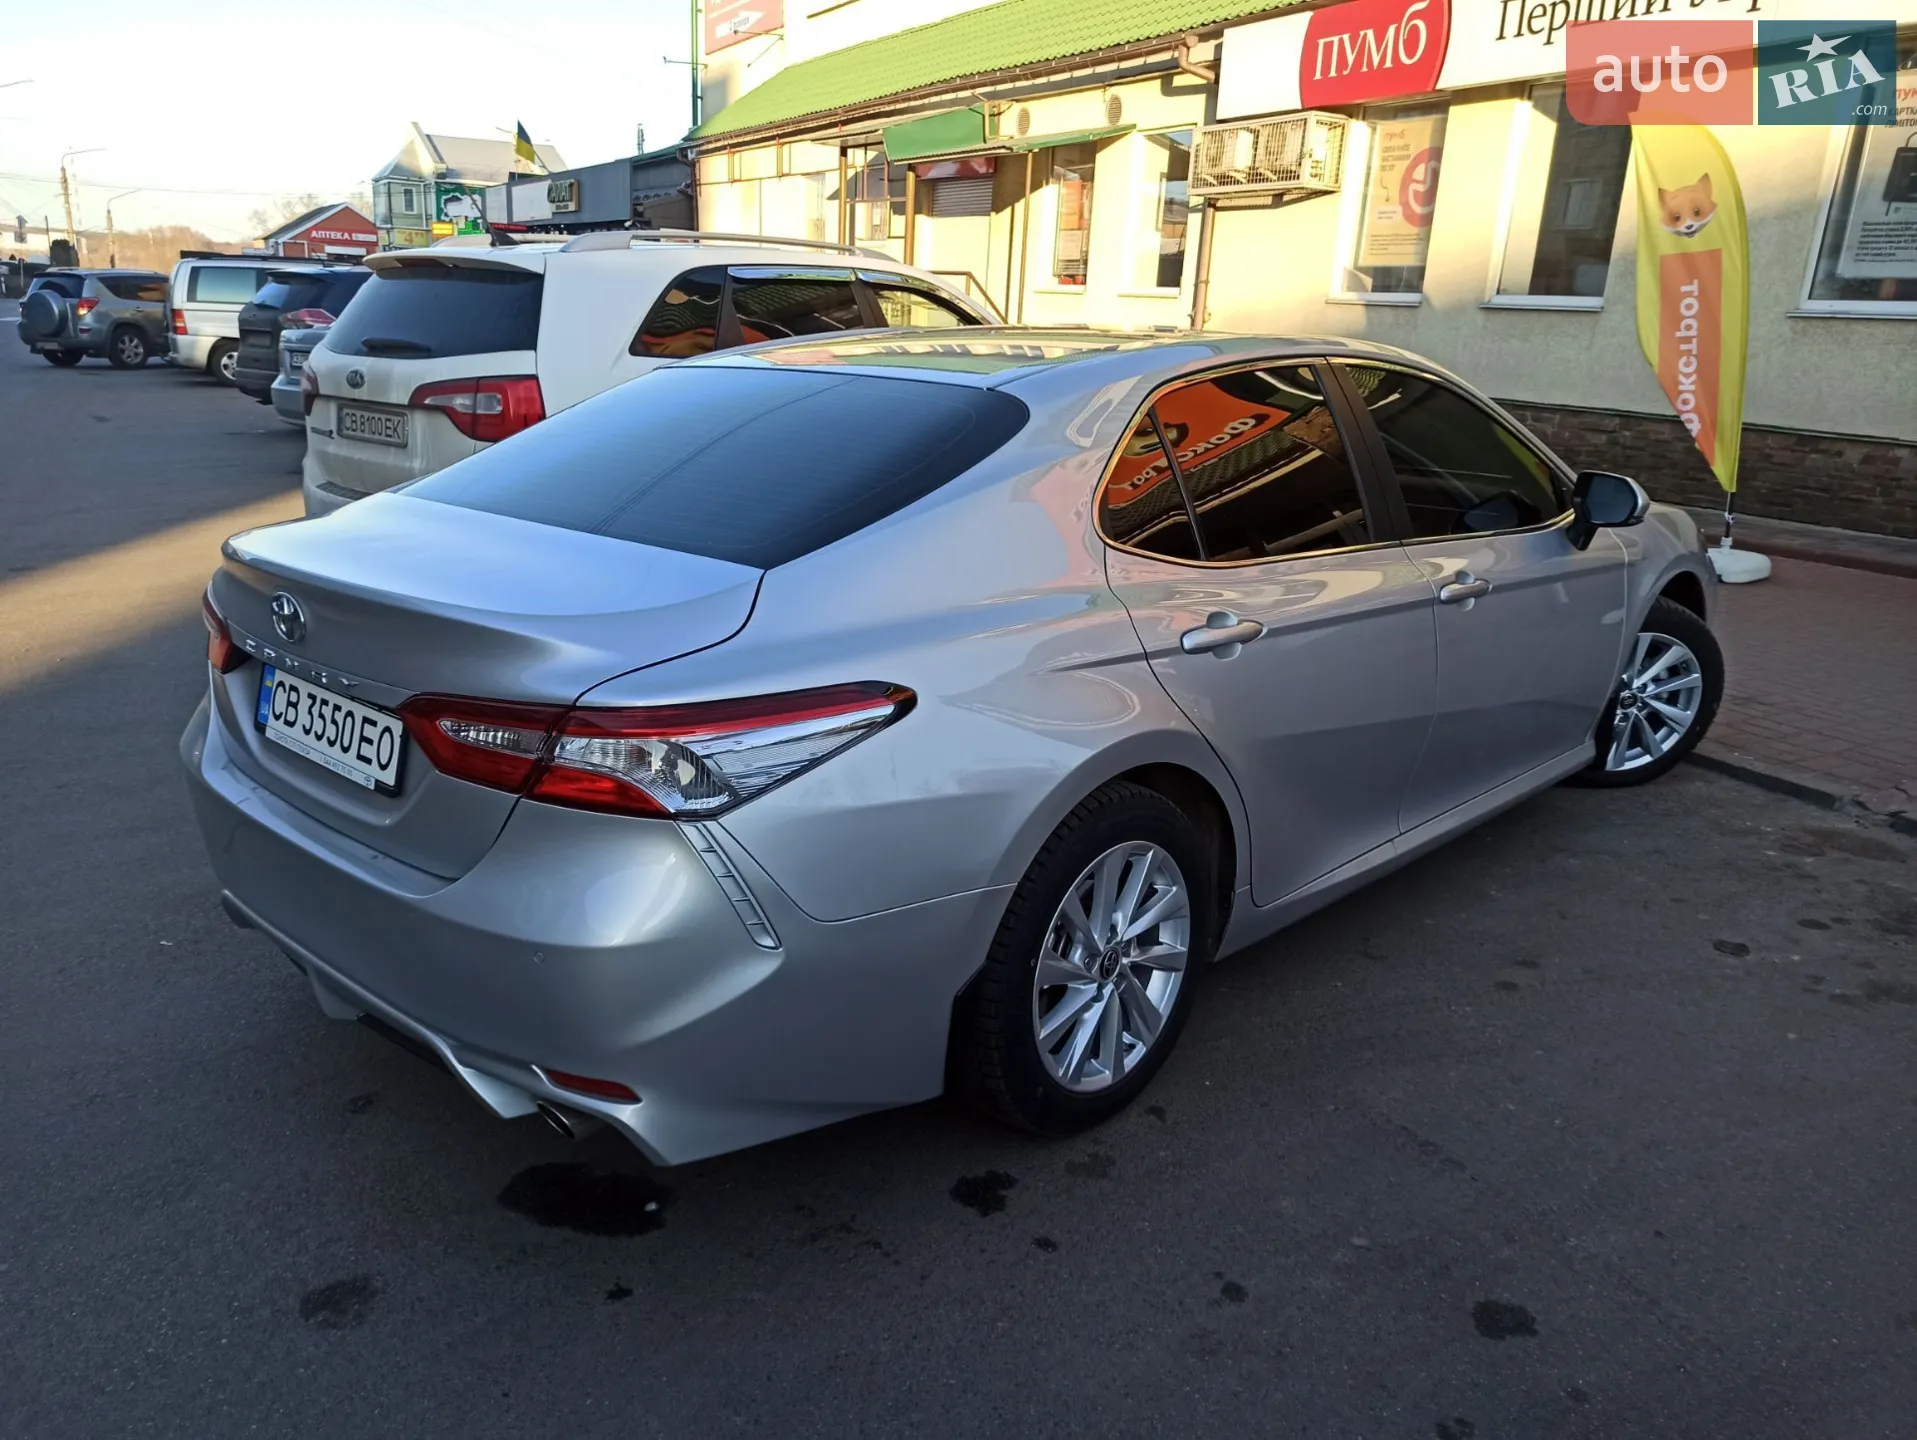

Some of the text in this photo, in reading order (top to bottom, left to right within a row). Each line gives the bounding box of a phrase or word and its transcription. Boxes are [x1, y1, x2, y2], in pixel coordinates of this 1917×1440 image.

[311, 230, 351, 241] АПТЕКА
[344, 412, 358, 433] CB
[360, 414, 383, 437] 8100
[384, 418, 401, 440] EK
[272, 680, 301, 728] CB
[302, 691, 356, 754] 3550
[356, 715, 395, 771] EO
